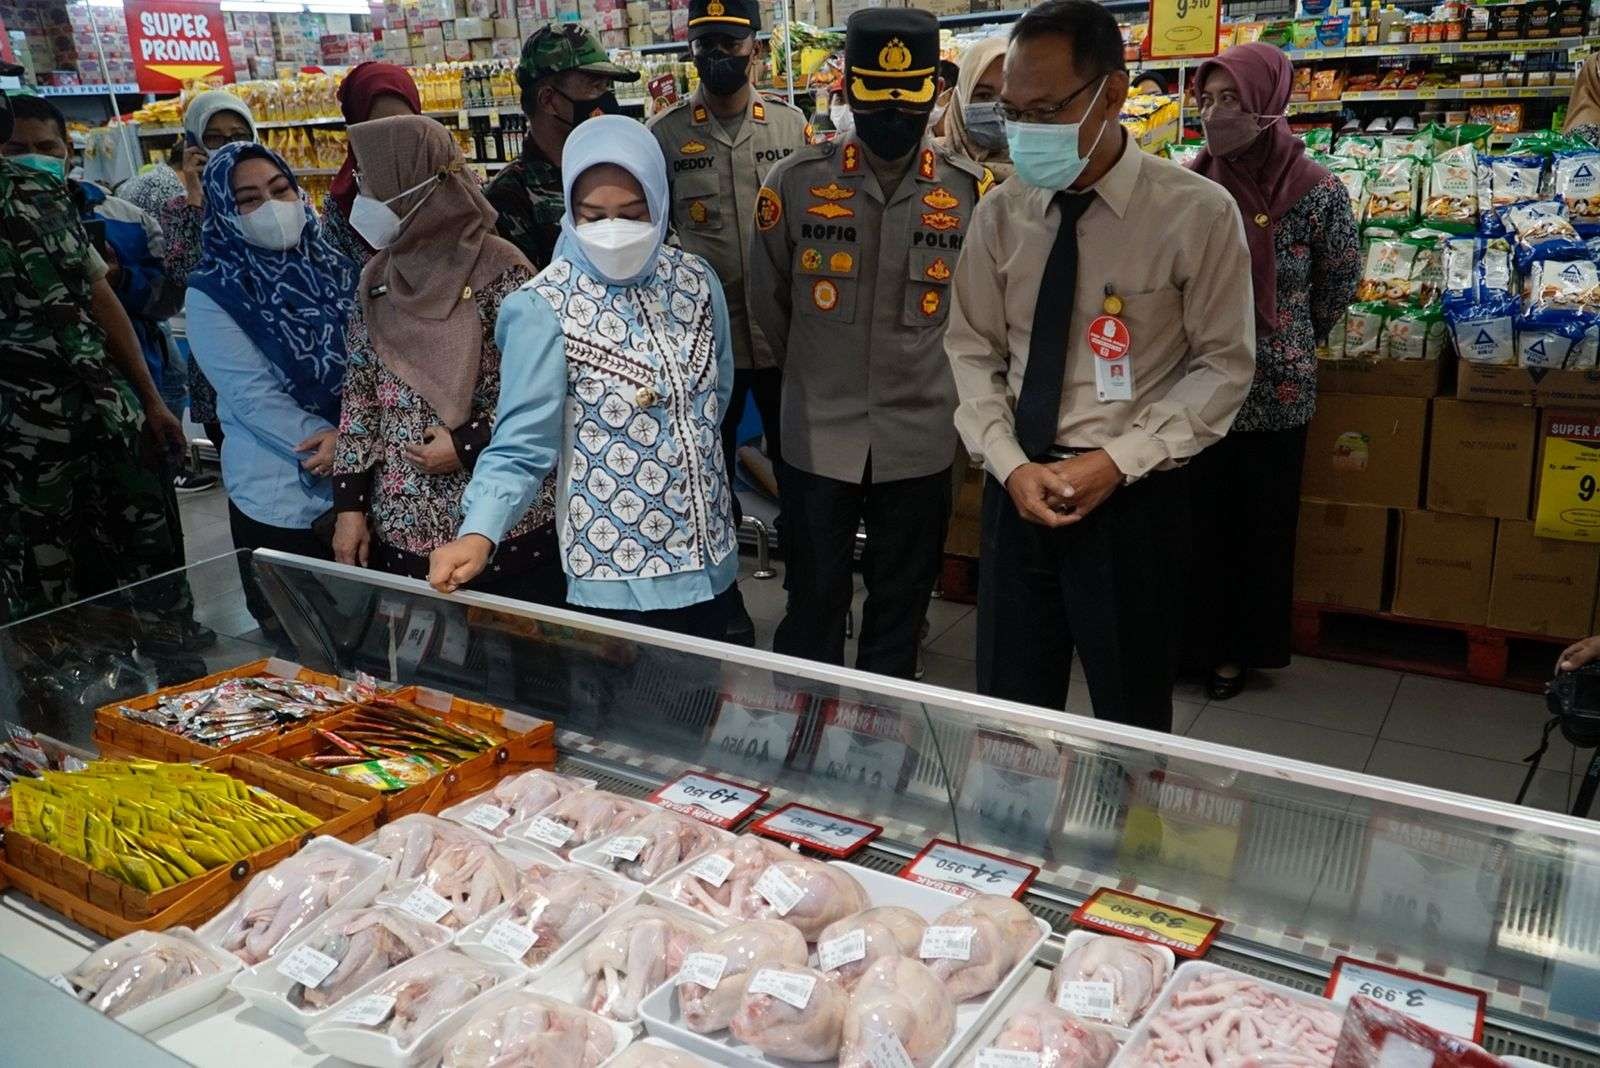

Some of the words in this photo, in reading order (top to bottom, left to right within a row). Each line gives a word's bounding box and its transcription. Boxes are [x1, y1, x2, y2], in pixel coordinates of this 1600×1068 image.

[140, 11, 211, 38] SUPER
[140, 38, 220, 62] PROMO!
[80, 86, 132, 94] PREMUM
[673, 156, 714, 172] DEDDY
[801, 224, 857, 242] ROFIQ
[1551, 423, 1590, 437] SUPER
[936, 859, 1009, 883] 34.950
[1110, 904, 1187, 929] 39.500
[1358, 982, 1427, 1007] 3.995
